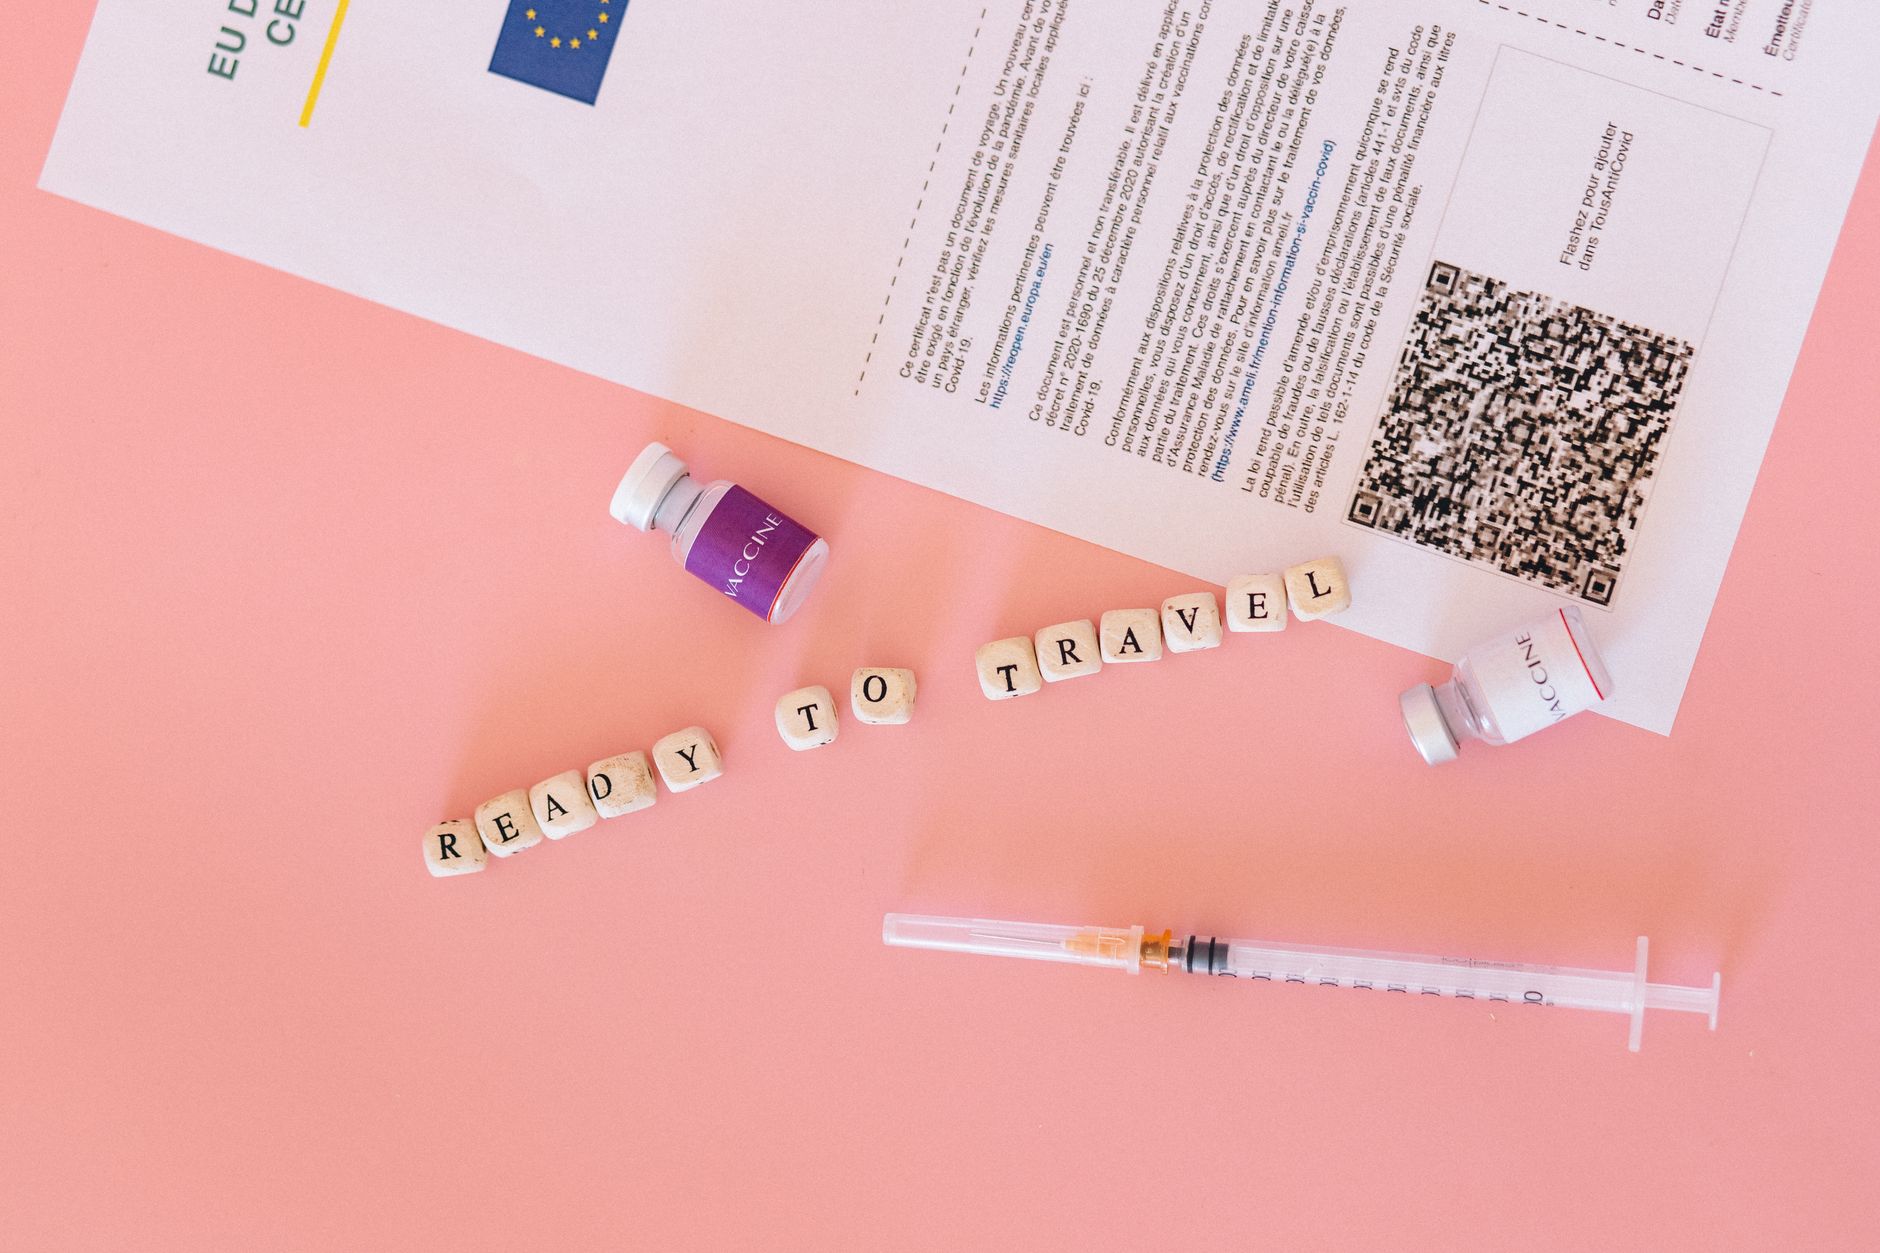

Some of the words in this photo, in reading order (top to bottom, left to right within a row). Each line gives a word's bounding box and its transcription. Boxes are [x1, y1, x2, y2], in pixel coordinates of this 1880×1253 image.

[207, 26, 247, 81] EU
[1076, 83, 1091, 99] ici
[1136, 60, 1158, 103] délivré
[1225, 33, 1252, 88] données
[1058, 100, 1086, 154] trouvées
[1130, 104, 1144, 124] est
[1196, 115, 1225, 177] protection
[1216, 89, 1234, 113] des
[908, 306, 933, 359] certificat
[936, 249, 952, 275] pas
[949, 168, 979, 230] document
[1002, 23, 1027, 77] nouveau
[913, 359, 932, 384] être
[925, 323, 944, 357] exigé
[940, 254, 967, 303] fonction
[1018, 35, 1040, 72] Avant
[937, 341, 955, 372] pays
[966, 237, 989, 281] vérifiez
[979, 216, 996, 236] les
[989, 162, 1015, 215] mesures
[1007, 100, 1035, 160] sanitaires
[1025, 55, 1051, 99] locales
[1034, 181, 1059, 233] peuvent
[1049, 155, 1067, 181] être
[1559, 209, 1589, 266] Flashez
[1582, 174, 1600, 208] pour
[1594, 121, 1618, 171] ajouter
[1577, 236, 1600, 271] dans
[1589, 131, 1634, 231] TousAntiCovid
[1044, 387, 1066, 428] décret
[1062, 303, 1094, 370] 2020-1690
[1099, 203, 1128, 265] décembre
[1119, 168, 1139, 202] 2020
[1132, 106, 1161, 167] autorisant
[1158, 40, 1182, 90] création
[1058, 370, 1089, 432] traitement
[1087, 297, 1113, 351] données
[1110, 226, 1137, 284] caractère
[1130, 162, 1158, 225] personnel
[1151, 124, 1170, 162] relatif
[1163, 100, 1179, 125] aux
[1171, 22, 1205, 98] vaccinations
[1091, 215, 1107, 240] non
[1149, 339, 1167, 368] vous
[1159, 281, 1186, 337] disposez
[1187, 222, 1206, 251] droit
[1223, 78, 1254, 149] rectification
[1151, 426, 1171, 465] partie
[1201, 277, 1222, 312] droits
[1236, 166, 1258, 210] auprès
[1257, 91, 1283, 146] directeur
[1282, 38, 1301, 70] votre
[1170, 203, 1195, 256] relatives
[1190, 341, 1217, 391] Maladie
[1216, 239, 1251, 321] rattachement
[1250, 154, 1279, 220] contactant
[1287, 39, 1320, 106] délégué(e)
[1255, 427, 1273, 458] rend
[1265, 375, 1290, 428] passible
[1304, 278, 1323, 311] et/ou
[1354, 96, 1384, 162] quiconque
[1383, 46, 1400, 77] rend
[1310, 317, 1344, 386] falsification
[1378, 156, 1398, 184] faux
[1415, 49, 1433, 81] ainsi
[1315, 401, 1333, 424] tels
[1325, 331, 1357, 399] documents
[1349, 301, 1367, 330] sont
[1359, 242, 1386, 301] passibles
[1392, 153, 1416, 204] pénalité
[1406, 90, 1437, 151] financière
[1436, 31, 1457, 62] titres
[1010, 234, 1041, 304] pertinentes
[1065, 255, 1093, 319] personnel
[1143, 379, 1170, 433] données
[1170, 325, 1189, 355] vous
[1206, 218, 1224, 249] ainsi
[1234, 133, 1253, 162] droit
[1144, 257, 1178, 330] dispositions
[1181, 412, 1210, 474] protection
[1228, 294, 1249, 326] Pour
[1248, 236, 1269, 275] savoir
[1262, 208, 1279, 236] plus
[1281, 106, 1313, 169] traitement
[1258, 441, 1285, 499] coupable
[1281, 374, 1308, 421] fraudes
[1310, 286, 1337, 335] fausses
[1329, 210, 1363, 285] déclarations
[1353, 158, 1380, 208] (articles
[1371, 121, 1392, 156] 441-1
[1406, 24, 1425, 56] code
[982, 304, 1017, 380] informations
[988, 242, 1055, 410] https://reopen.europa.eu/en
[1035, 340, 1065, 402] document
[1058, 317, 1072, 339] est
[1137, 331, 1153, 355] aux
[1197, 402, 1230, 478] rendez-vous
[1235, 340, 1251, 364] site
[1271, 211, 1294, 258] ameli.fr
[1313, 443, 1336, 489] articles
[1332, 370, 1360, 424] 162-1-14
[1359, 318, 1378, 351] code
[1379, 232, 1406, 284] Sécurité
[973, 381, 992, 404] Les
[1104, 356, 1144, 447] Conformément
[724, 513, 783, 598] VACCINE
[437, 744, 700, 860] READY
[797, 675, 888, 732] TO
[996, 570, 1332, 693] TRAVEL
[1513, 630, 1567, 722] VACCINE
